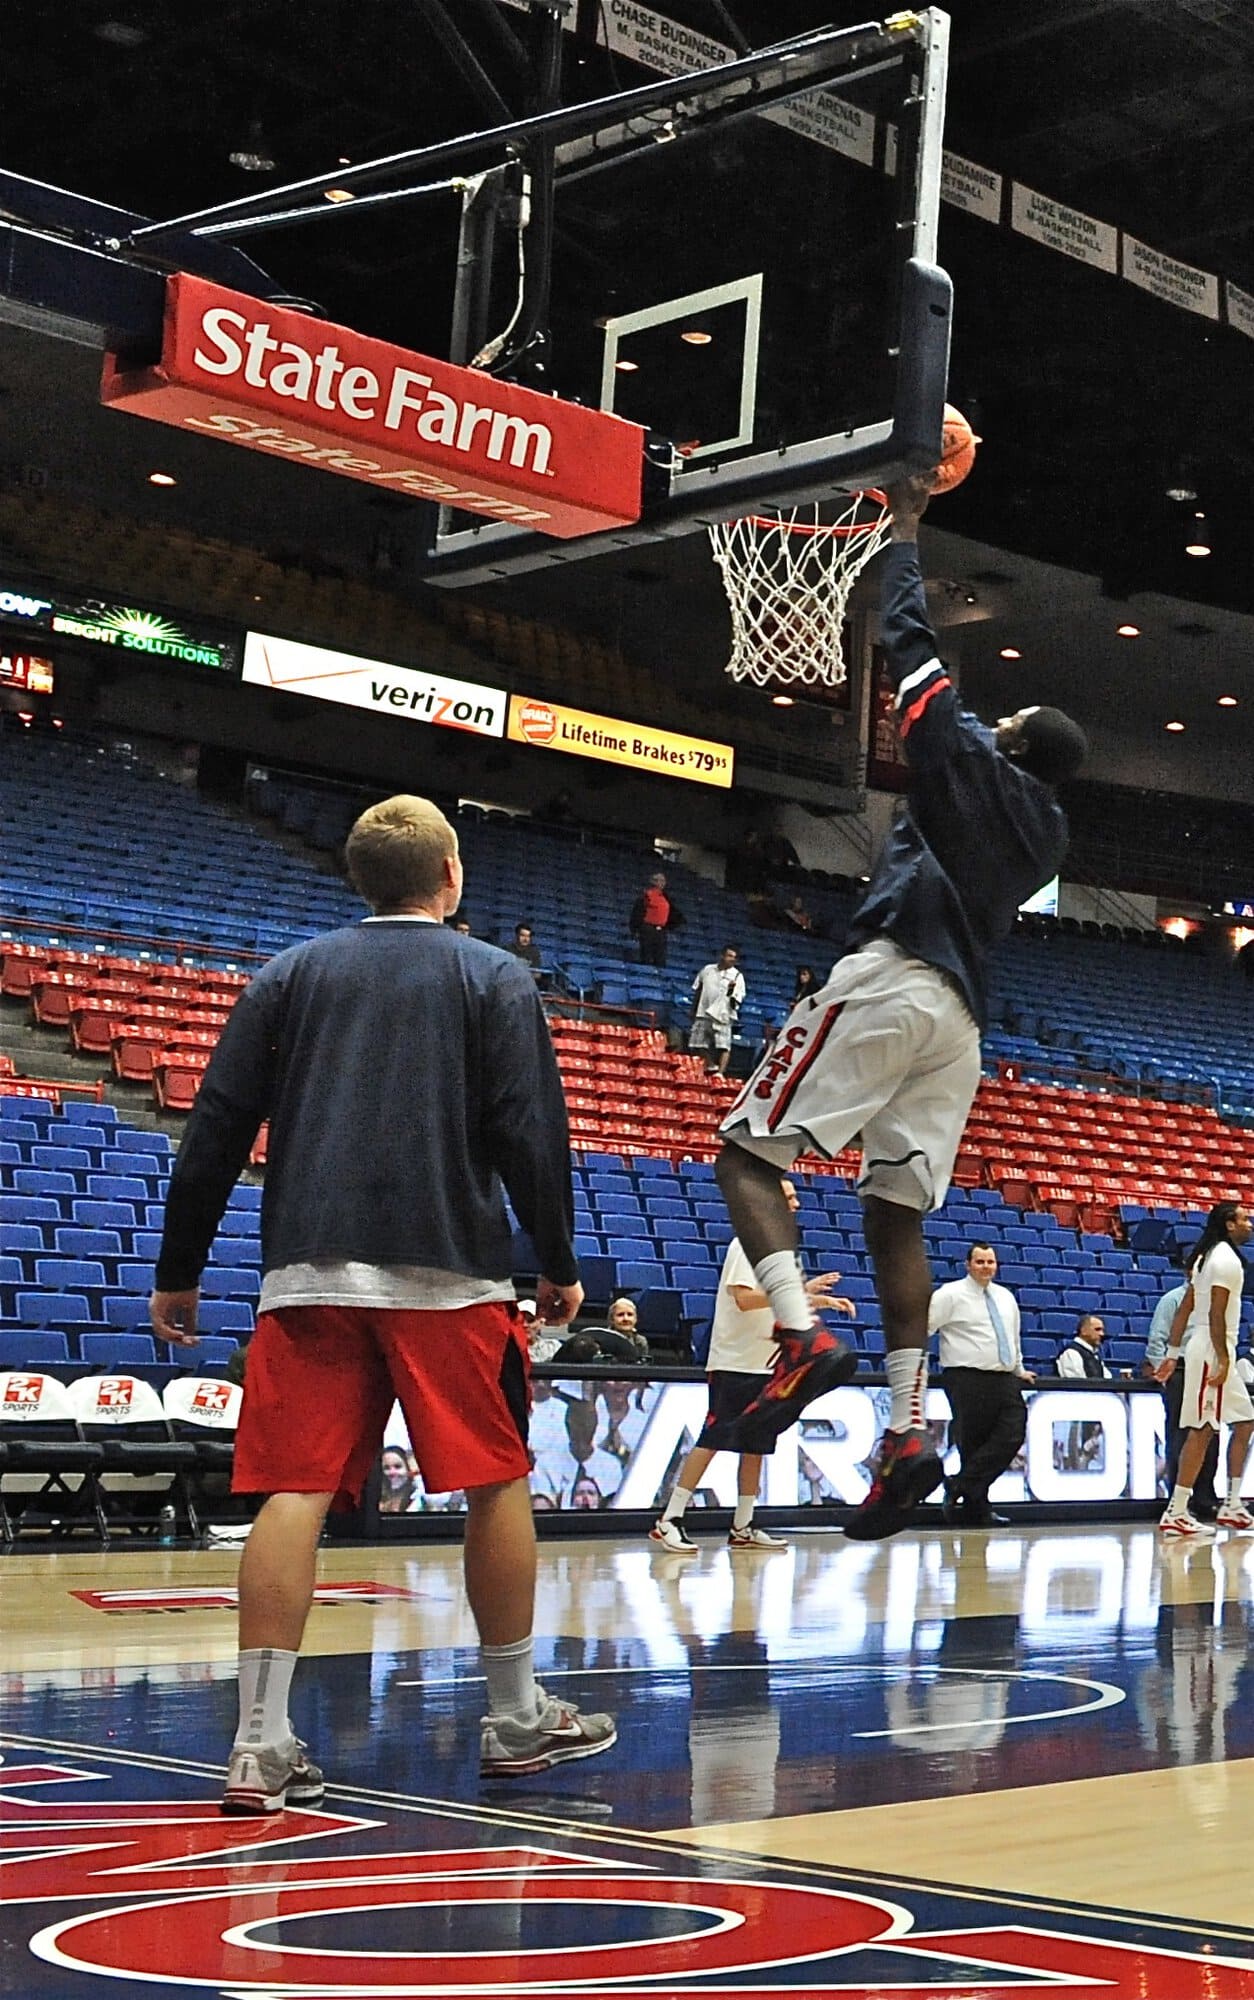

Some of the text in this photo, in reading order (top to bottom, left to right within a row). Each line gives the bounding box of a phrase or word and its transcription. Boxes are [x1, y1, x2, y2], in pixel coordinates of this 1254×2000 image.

[611, 0, 726, 63] CHASE BUDINGER
[634, 32, 711, 70] BASKETBAL
[816, 94, 862, 127] ARENAS
[943, 153, 997, 191] OUDAMIRE
[1031, 194, 1055, 218] LUKE
[53, 616, 220, 667] BRIGHT SOLUTIONS
[371, 680, 494, 726] verizon
[562, 721, 627, 754] Lifetime
[633, 739, 686, 766] Brakes
[754, 1026, 808, 1099] CATS
[1005, 1067, 1014, 1081] 4
[5, 1376, 43, 1403] 2K
[96, 1380, 133, 1406] 2K
[193, 1382, 232, 1410] 2K
[2, 1403, 39, 1412] SPORTS
[95, 1406, 131, 1415] SPORTS
[189, 1407, 225, 1418] SPORTS
